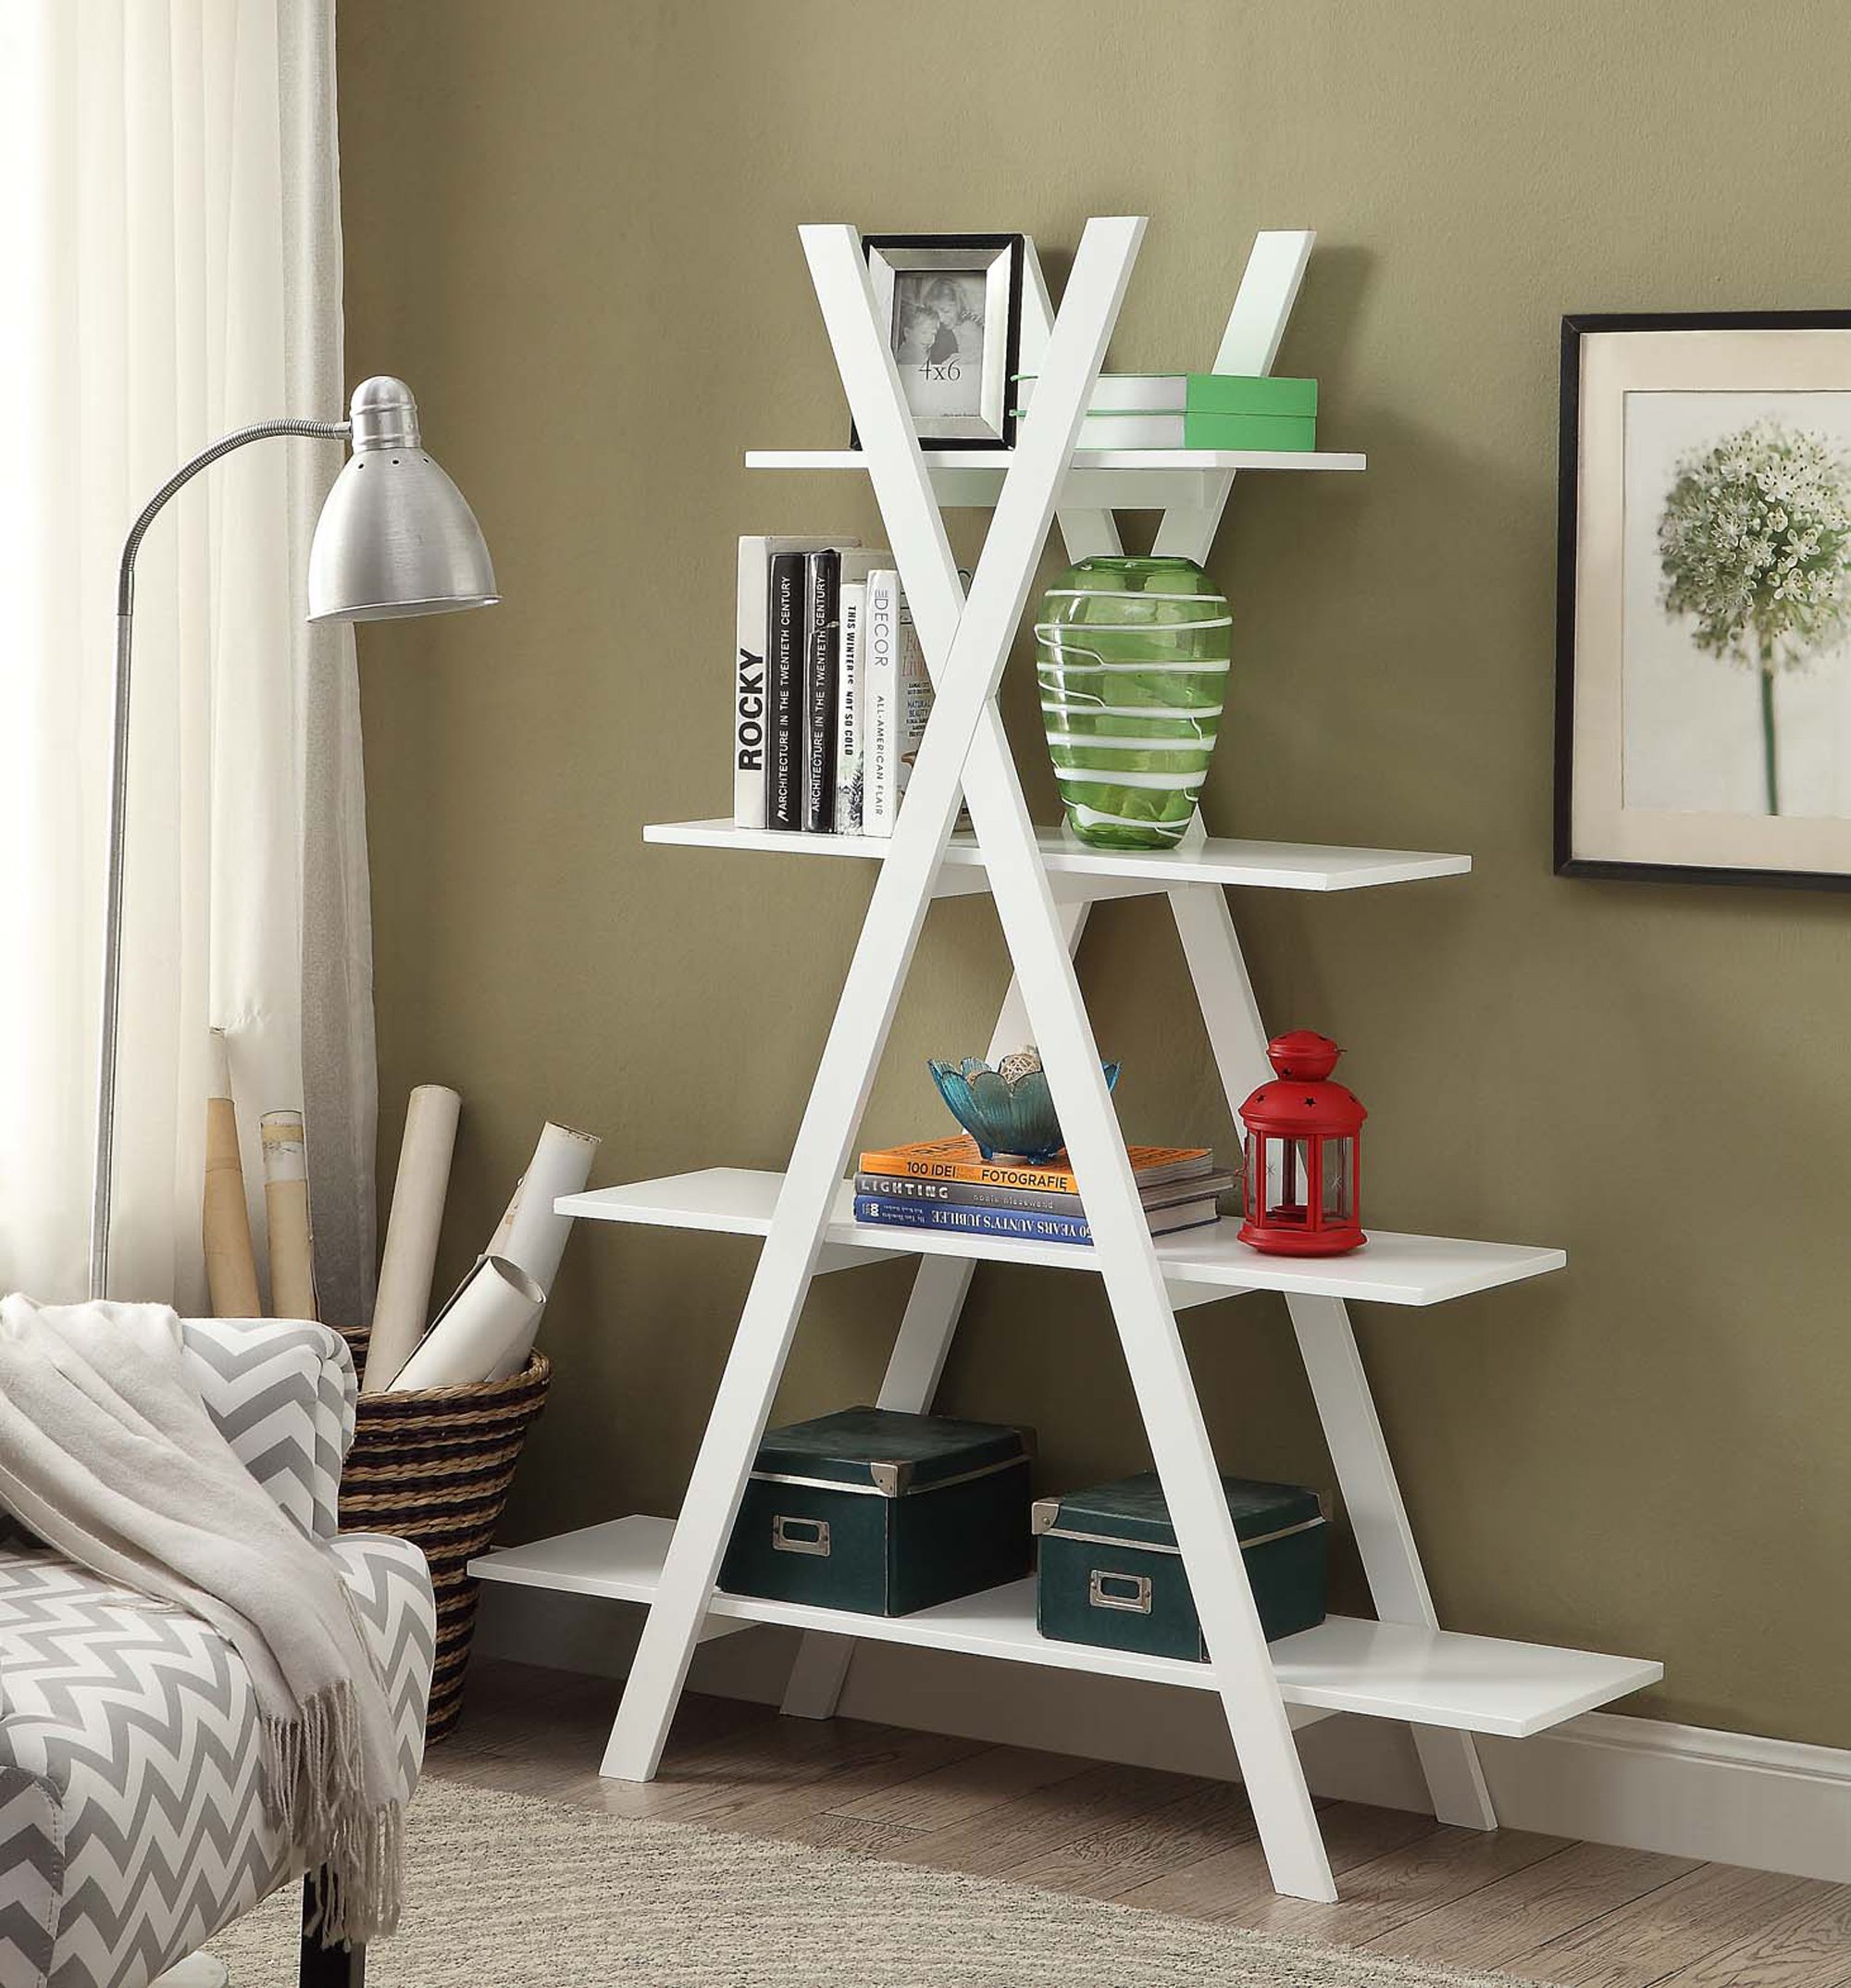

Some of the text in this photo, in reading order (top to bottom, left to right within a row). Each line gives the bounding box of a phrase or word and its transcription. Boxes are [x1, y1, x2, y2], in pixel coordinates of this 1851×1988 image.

[918, 357, 962, 381] 4x6
[780, 576, 791, 626] CENTURY
[815, 577, 826, 626] CENTURY
[847, 605, 857, 629] THIS
[846, 632, 856, 671] WINTER
[739, 649, 764, 771] ROCKY
[779, 690, 789, 711] THE
[815, 691, 826, 712] THE
[845, 691, 854, 711] NOT
[779, 714, 789, 726] IN
[814, 716, 824, 727] IN
[844, 714, 853, 727] SO
[844, 729, 854, 756] COLD
[875, 695, 885, 815] ALL-AMERICAN FLAIR
[777, 730, 789, 811] ARCHITECTURE
[811, 731, 823, 812] ARCHITECTURE
[906, 1161, 928, 1174] 100
[931, 1163, 957, 1178] IDEI
[861, 1181, 949, 1199] LIGHTING
[931, 1210, 982, 1227] JUBILEE
[983, 1215, 1035, 1234] AUNTY'S
[1037, 1222, 1076, 1236] YEARS
